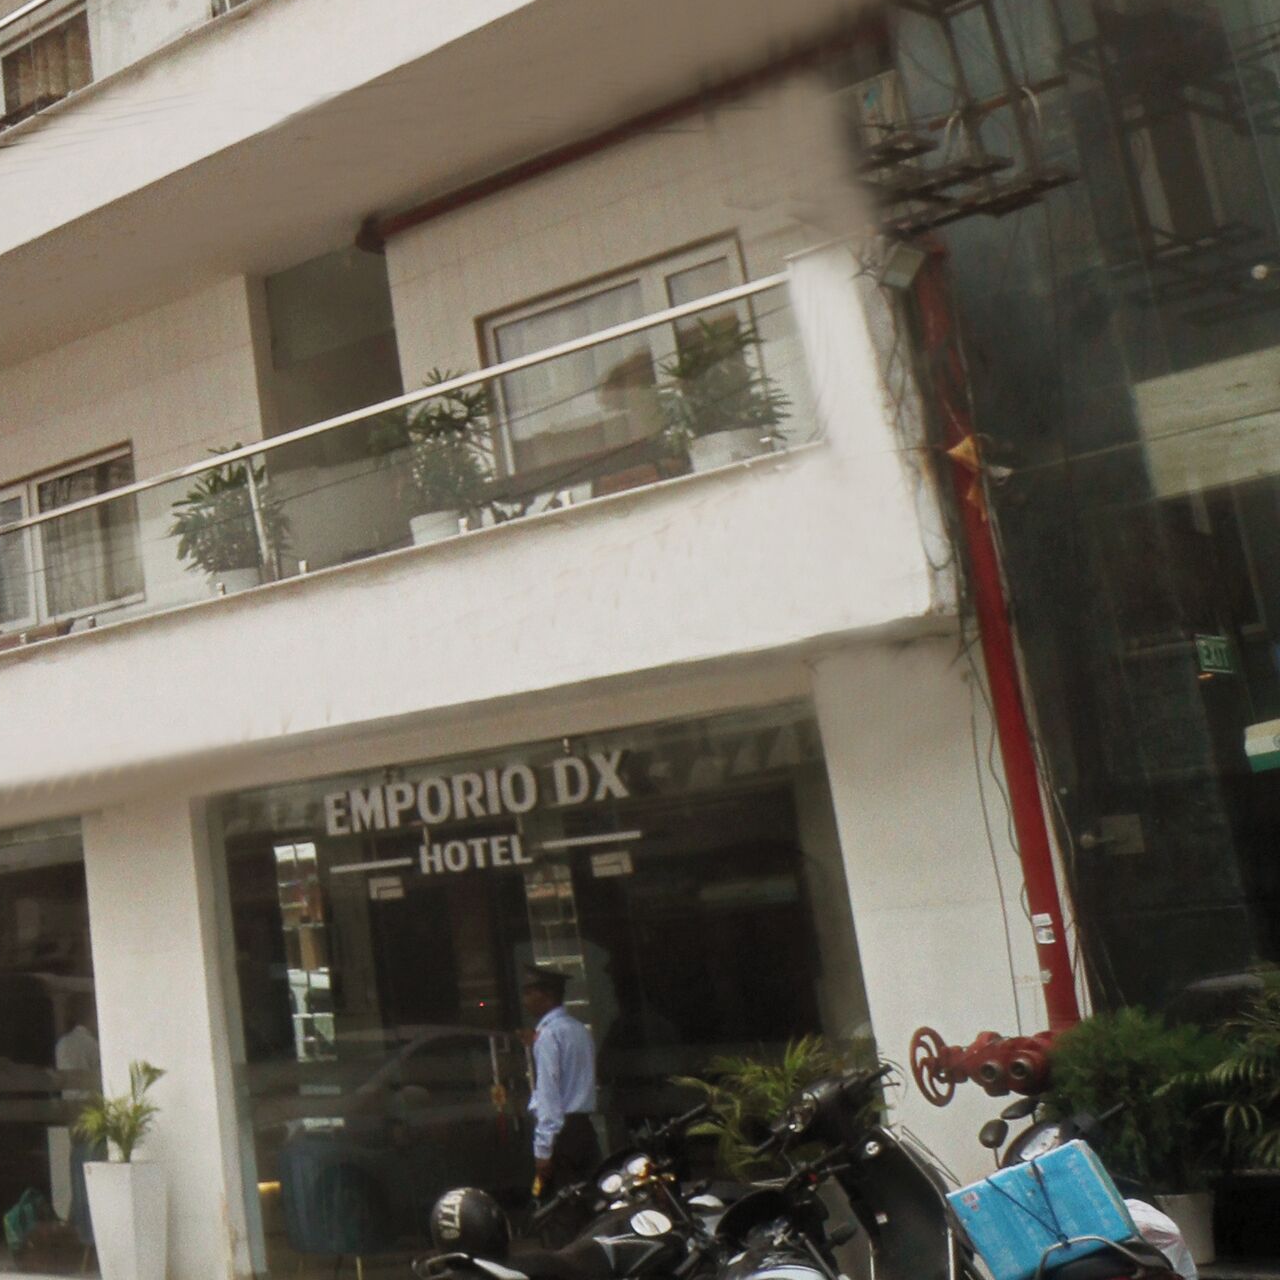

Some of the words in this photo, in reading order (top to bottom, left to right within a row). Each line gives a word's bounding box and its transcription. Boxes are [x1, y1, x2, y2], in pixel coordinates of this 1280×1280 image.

[324, 764, 537, 836] EMPORIO
[552, 750, 630, 806] DX
[419, 834, 534, 874] HOTEL
